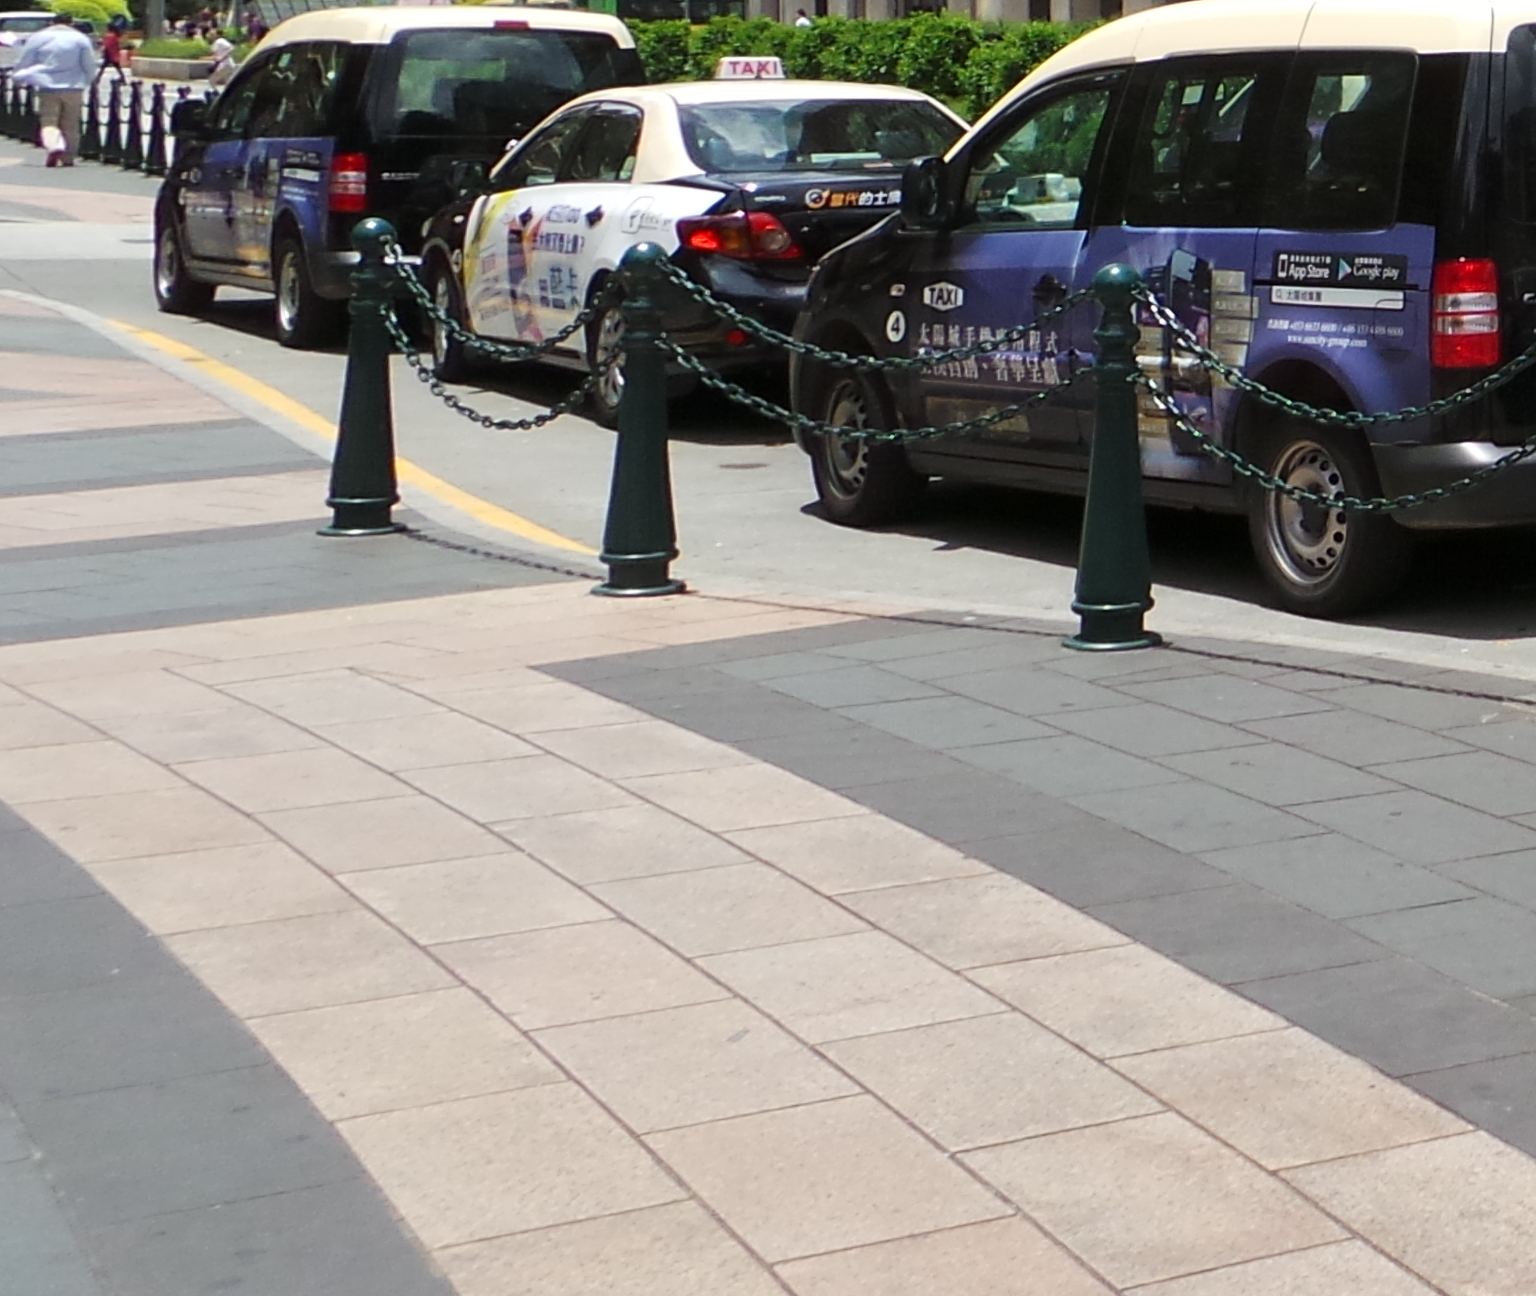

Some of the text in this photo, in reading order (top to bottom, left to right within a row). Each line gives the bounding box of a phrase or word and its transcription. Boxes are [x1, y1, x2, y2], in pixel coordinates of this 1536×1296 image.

[729, 60, 778, 75] TAXI
[1289, 264, 1331, 281] App Store
[1353, 264, 1381, 279] Google
[929, 286, 959, 305] TAXI
